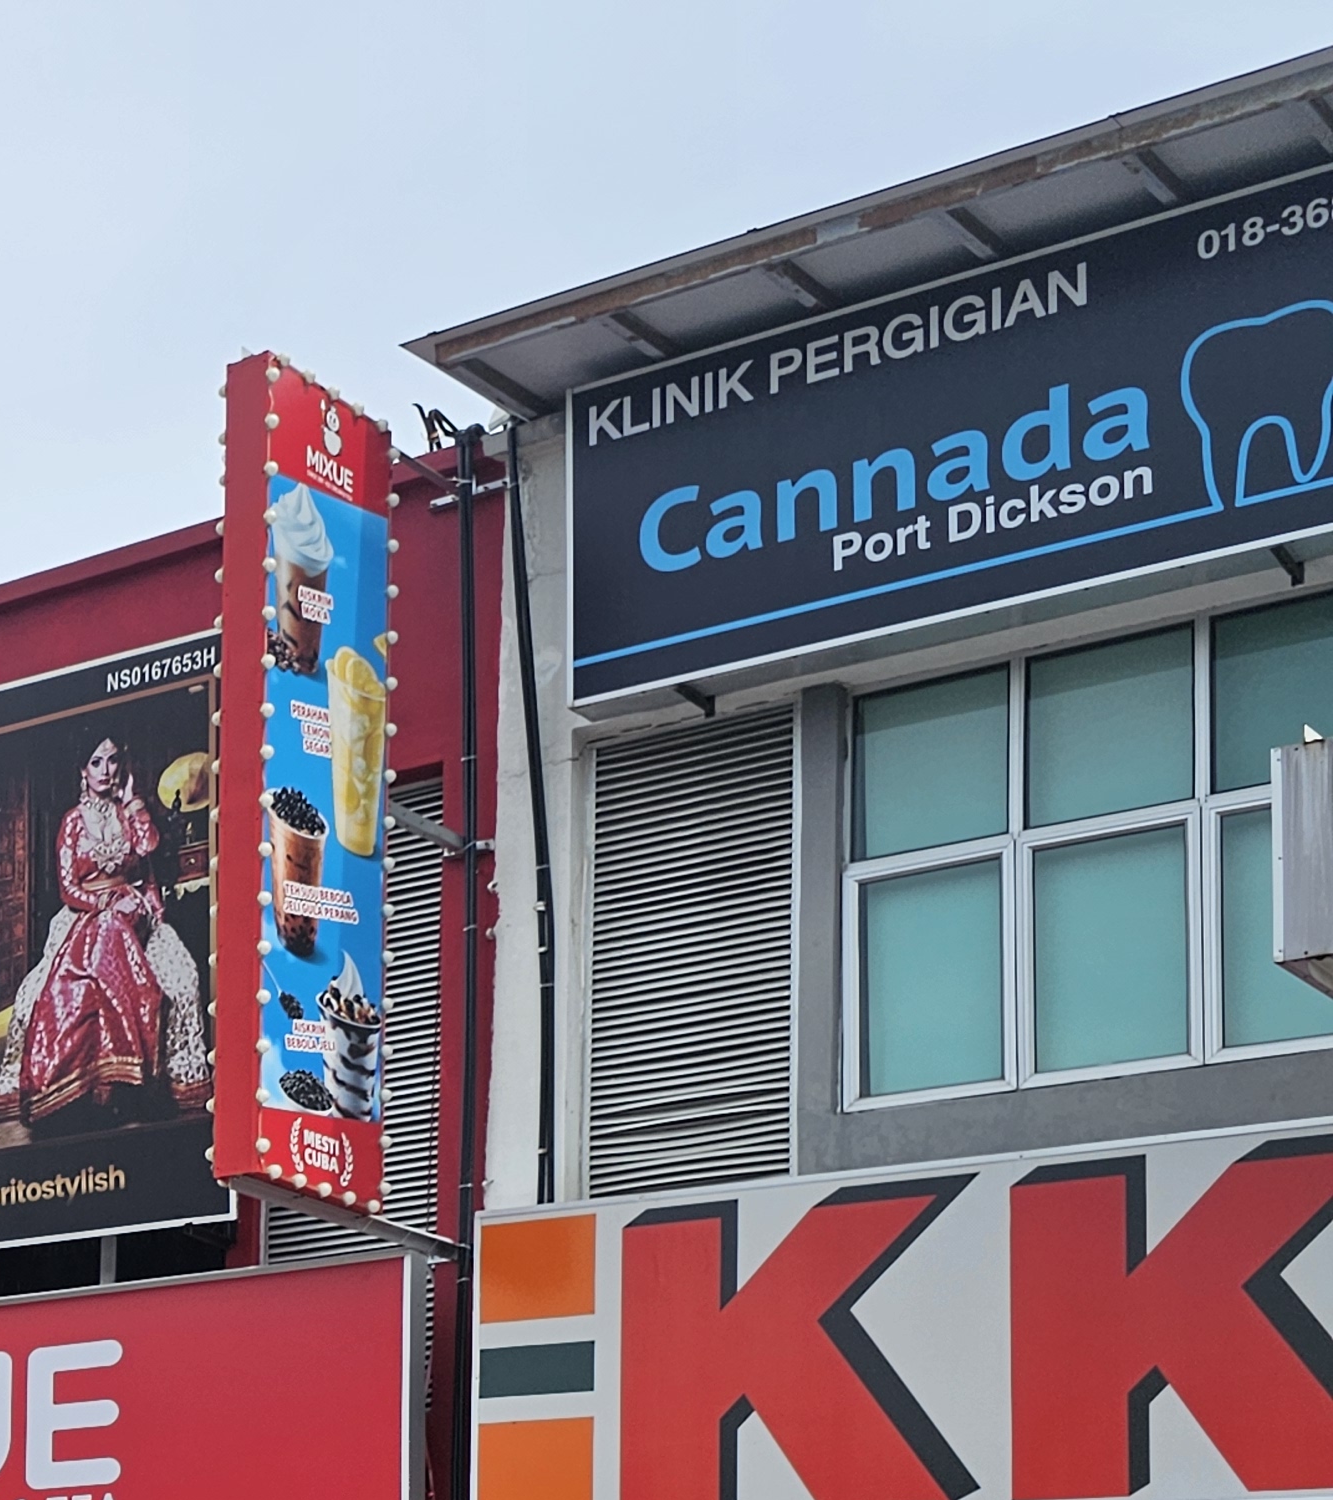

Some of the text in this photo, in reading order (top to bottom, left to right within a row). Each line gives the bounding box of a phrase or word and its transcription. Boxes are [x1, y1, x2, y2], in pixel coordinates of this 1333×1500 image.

[1197, 197, 1333, 260] 018-36
[588, 262, 1089, 446] KLINIK PERGIGIAN
[306, 444, 354, 494] MIXUE
[638, 383, 1152, 573] Cannada
[832, 463, 1154, 571] Port Dickson
[105, 646, 217, 694] NS0167653H
[292, 703, 330, 724] PERAHAN
[304, 1128, 340, 1157] MESTI
[304, 1146, 339, 1174] CUBA
